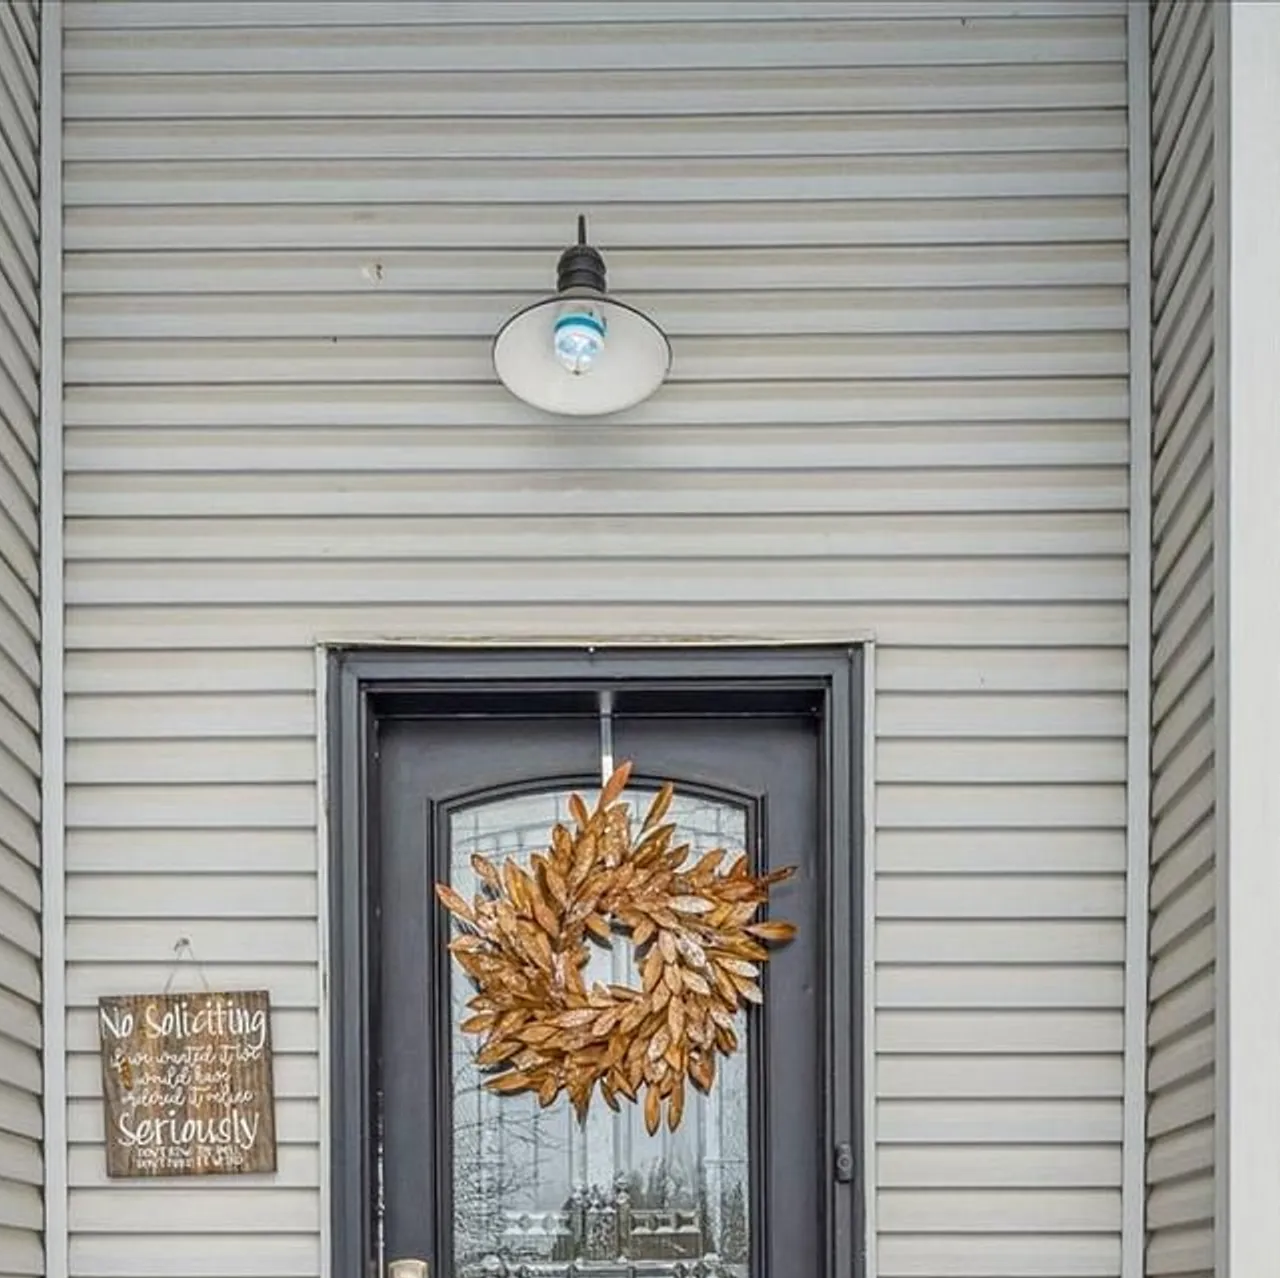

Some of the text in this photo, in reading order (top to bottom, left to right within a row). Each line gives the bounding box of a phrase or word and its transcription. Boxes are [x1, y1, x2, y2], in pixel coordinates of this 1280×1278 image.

[99, 1001, 267, 1049] No Soliciting
[118, 1108, 260, 1150] Seriously
